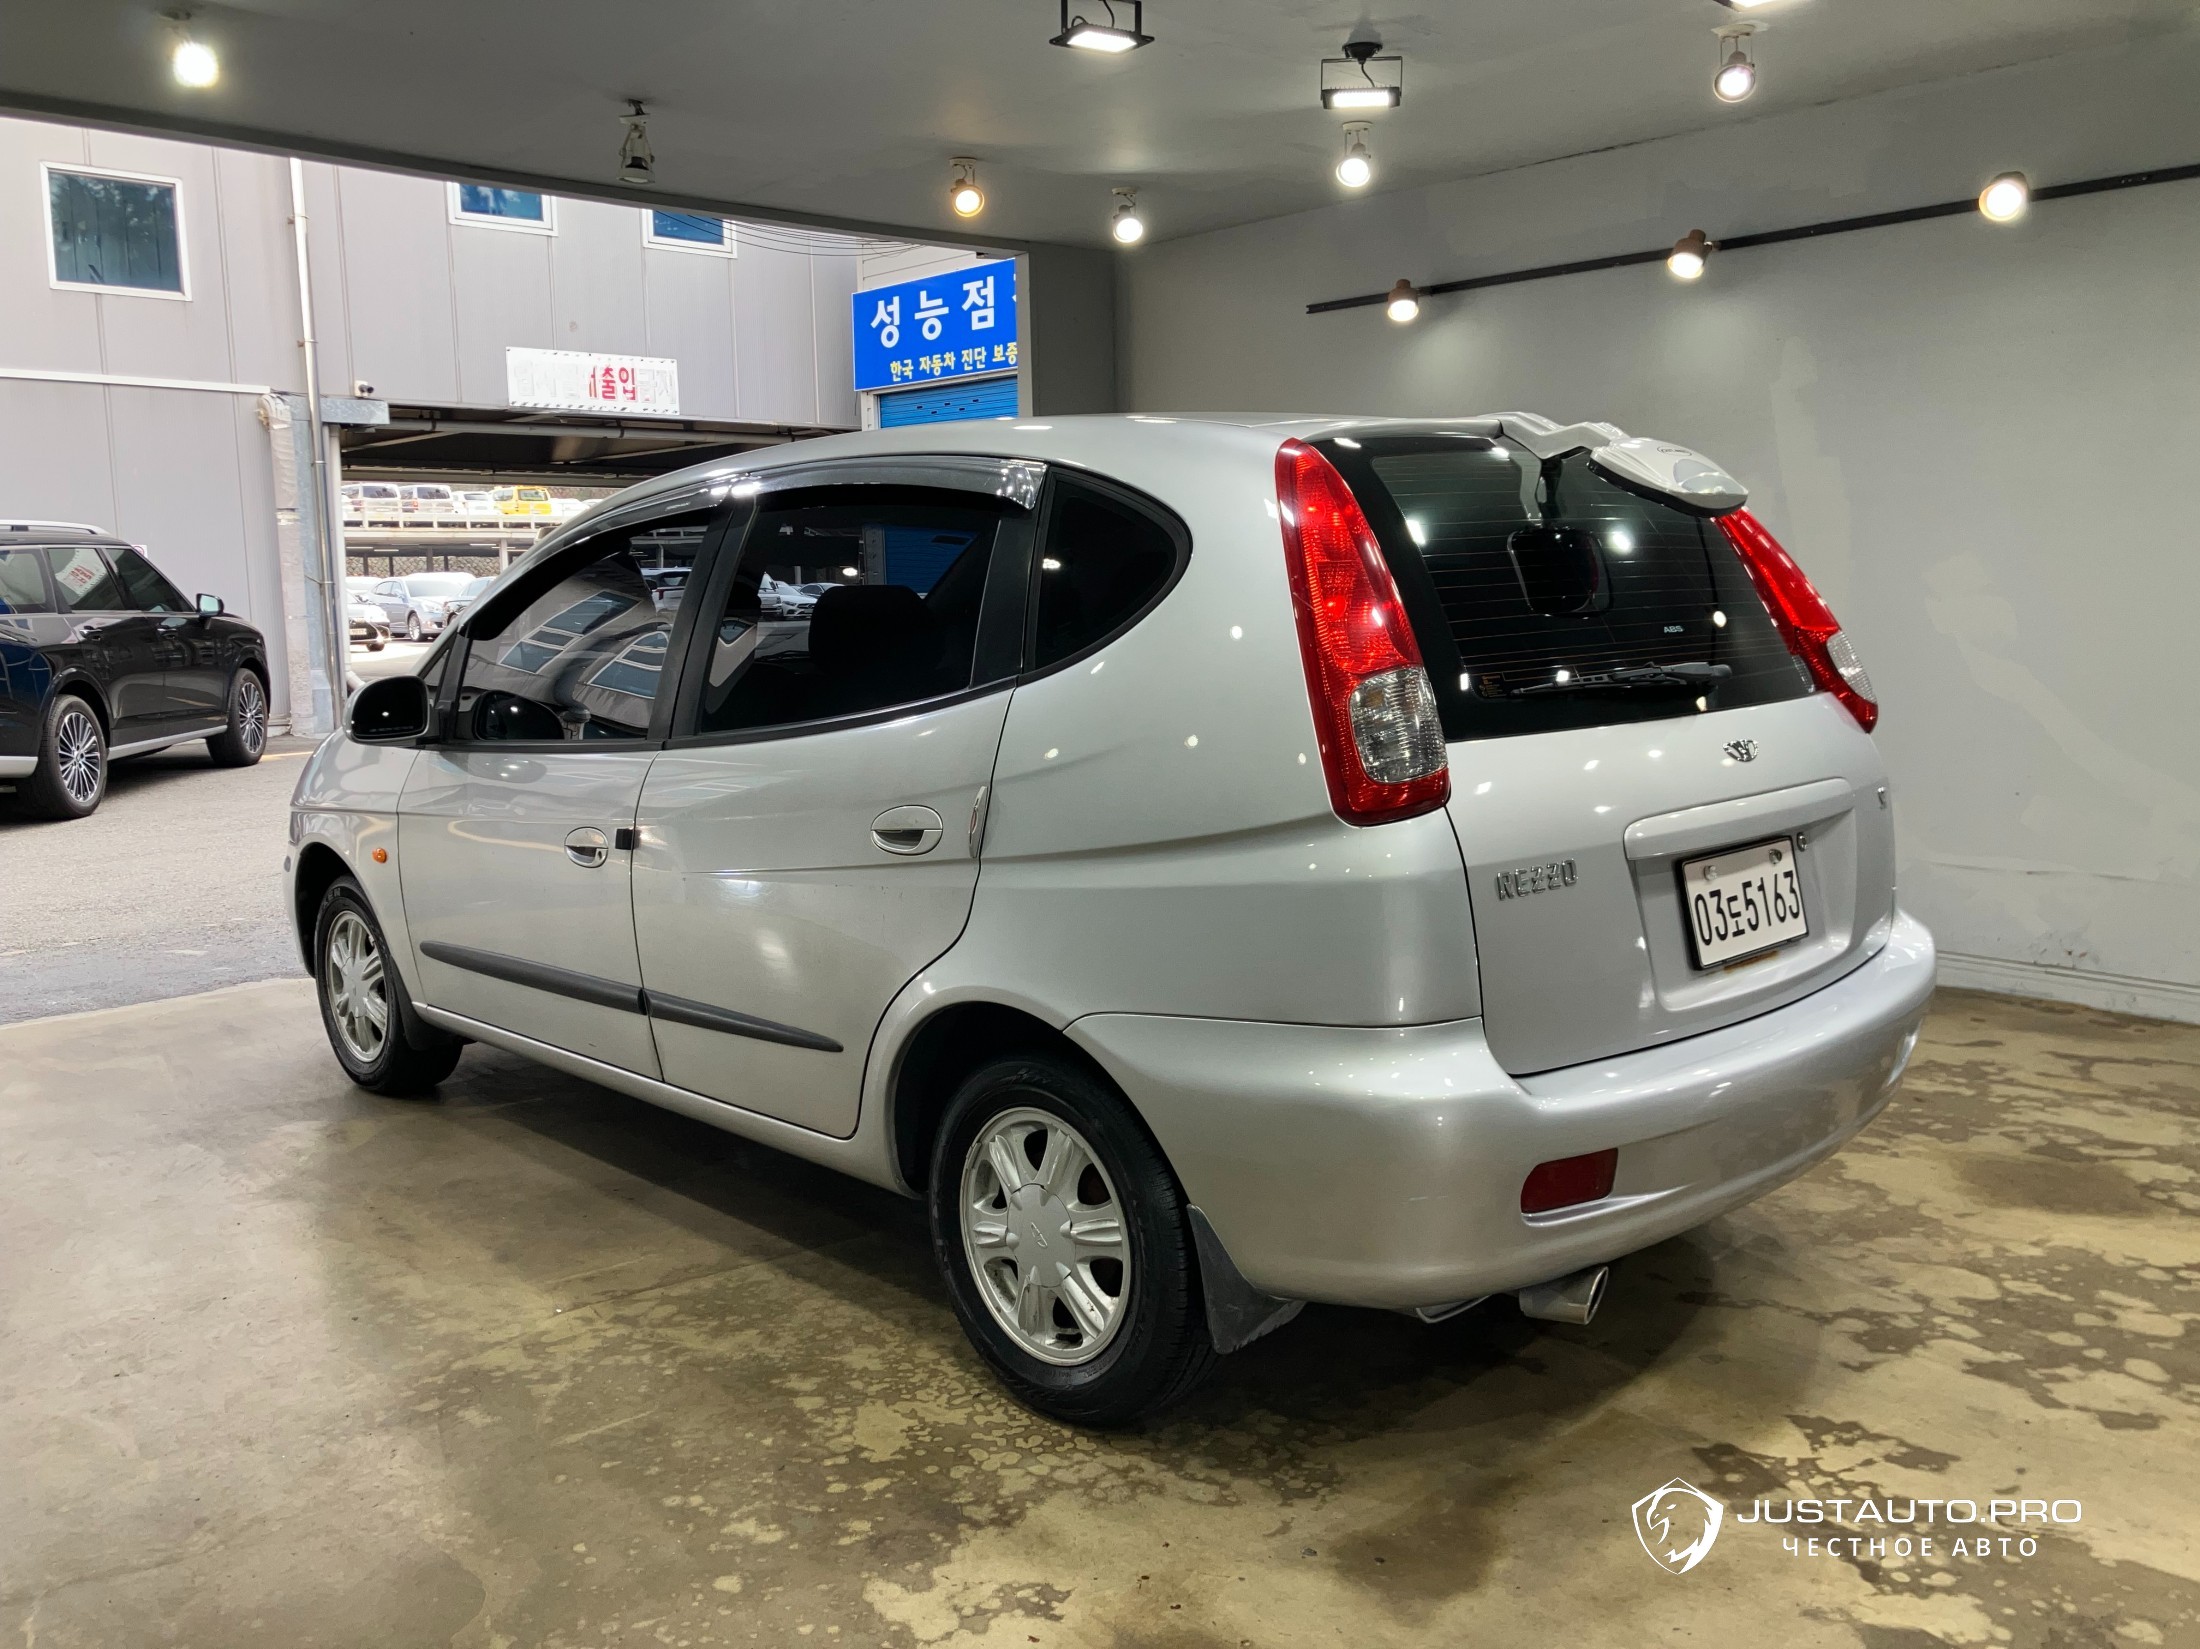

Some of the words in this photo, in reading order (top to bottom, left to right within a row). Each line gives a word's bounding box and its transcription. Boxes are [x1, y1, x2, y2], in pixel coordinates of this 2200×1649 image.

[871, 275, 1017, 348] 성능점
[890, 359, 914, 382] 한국
[919, 351, 956, 376] 자동차
[961, 346, 987, 370] 진단
[1663, 625, 1684, 634] ABS
[1695, 870, 1800, 946] 03도5163
